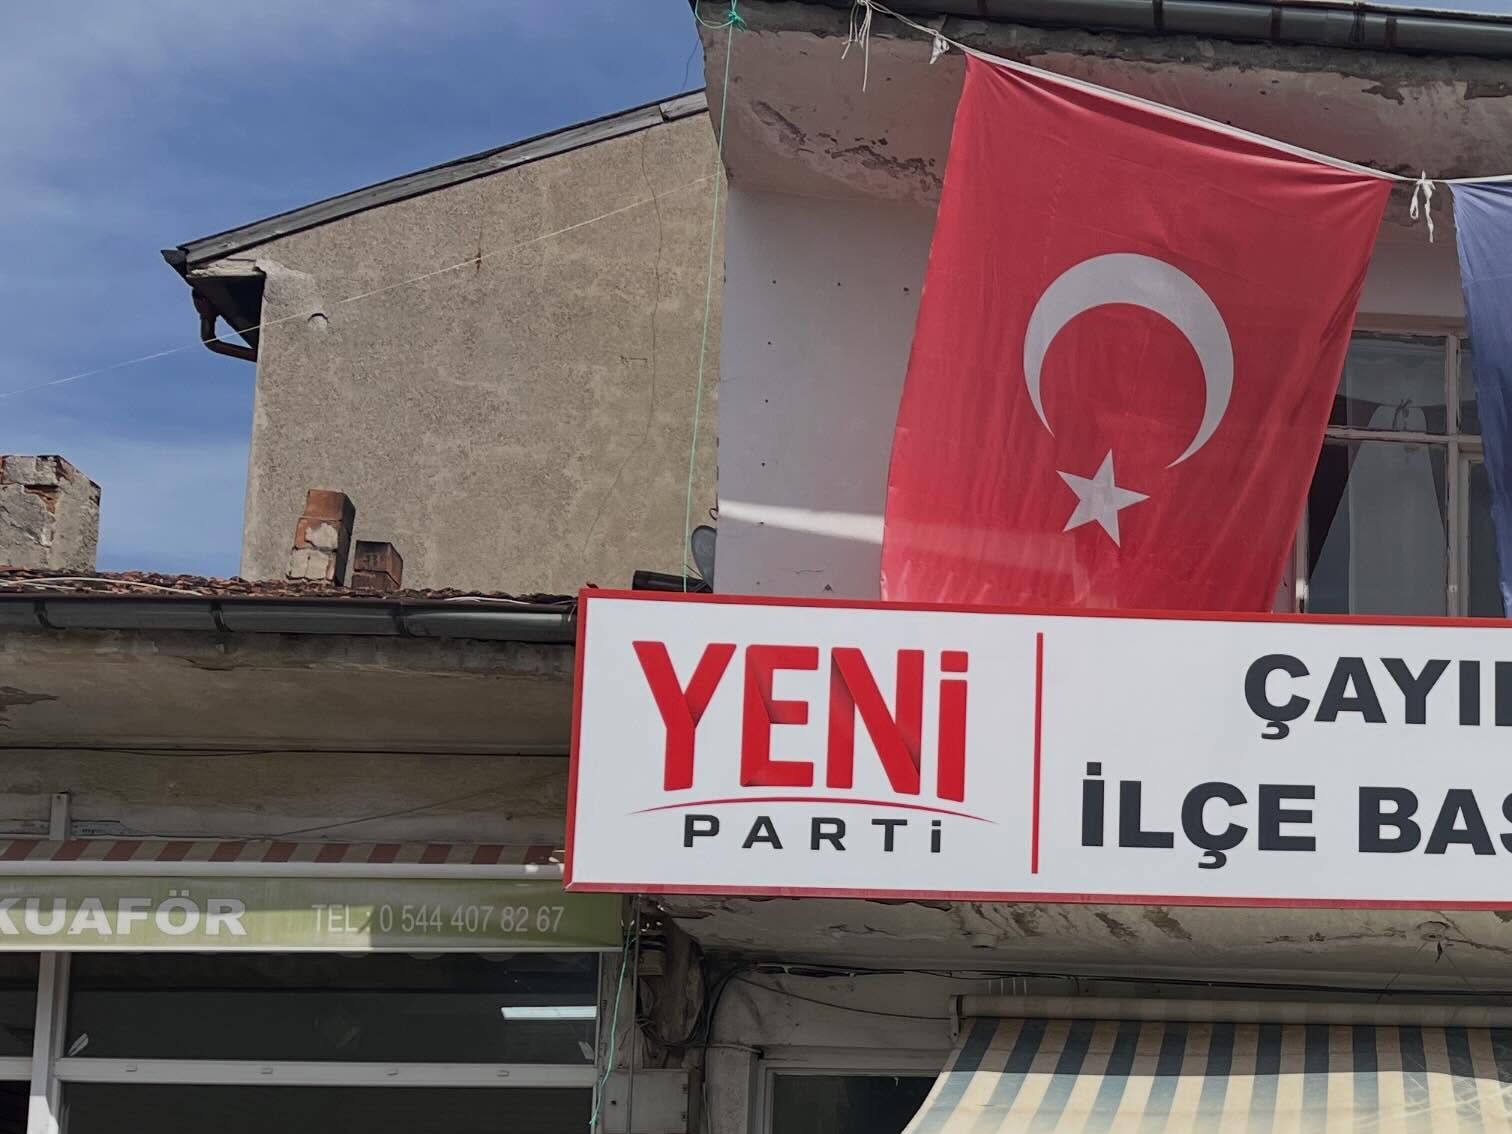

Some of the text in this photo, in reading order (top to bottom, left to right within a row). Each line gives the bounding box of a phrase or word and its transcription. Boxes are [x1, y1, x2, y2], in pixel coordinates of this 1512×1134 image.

[1081, 762, 1317, 869] İLÇE
[380, 904, 394, 934] 0
[401, 904, 444, 934] 544
[451, 904, 493, 934] 407
[501, 904, 529, 934] 82
[536, 904, 566, 934] 67
